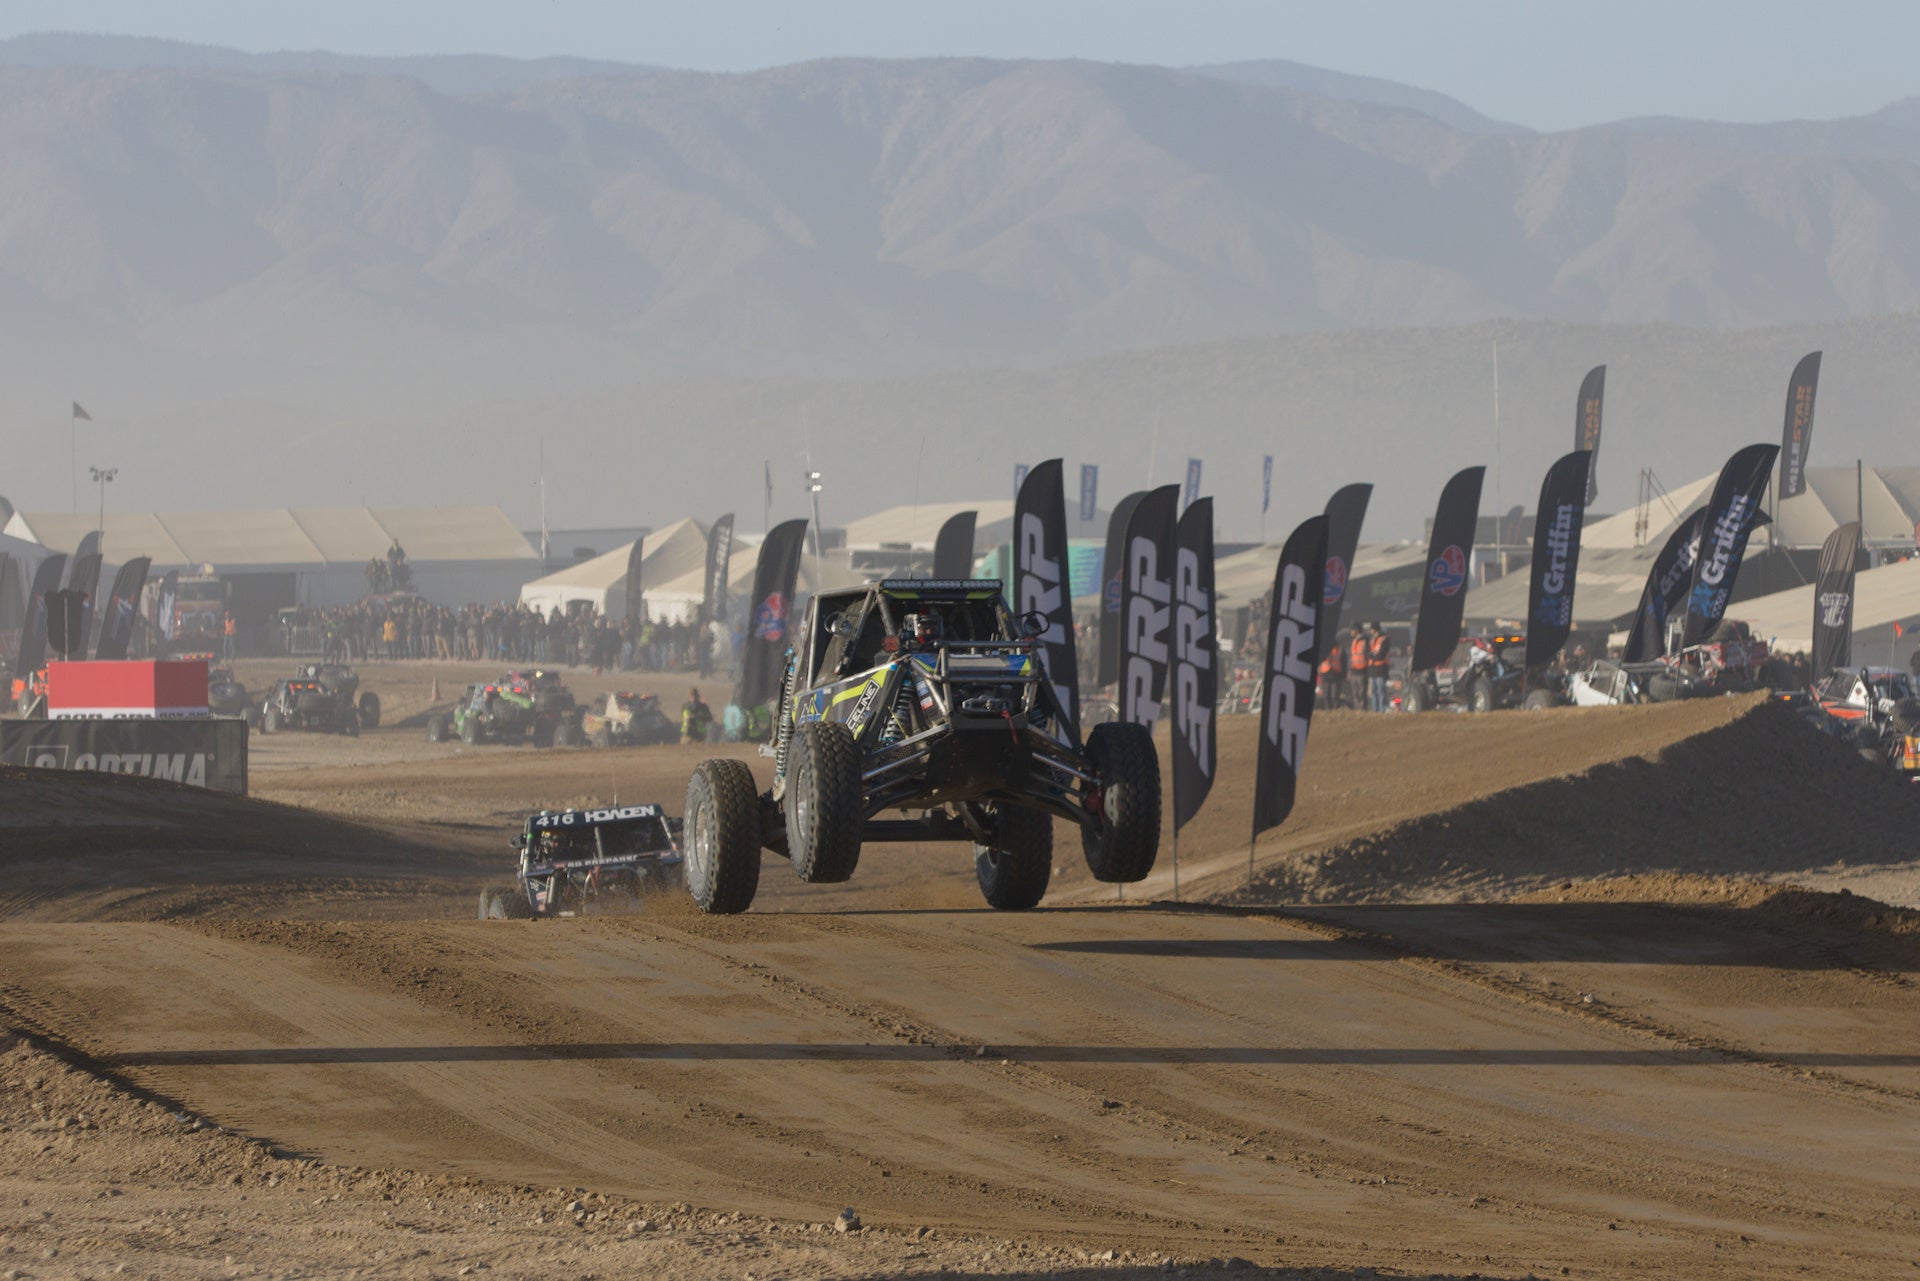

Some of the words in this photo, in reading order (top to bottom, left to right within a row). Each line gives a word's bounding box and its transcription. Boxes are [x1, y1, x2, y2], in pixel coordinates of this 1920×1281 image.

[1788, 384, 1805, 494] MILESTAR
[1543, 505, 1573, 594] Griffin
[1701, 494, 1749, 585] Griffin
[1268, 563, 1318, 777] PRP
[536, 814, 574, 827] 416
[584, 805, 655, 823] HOWDEN
